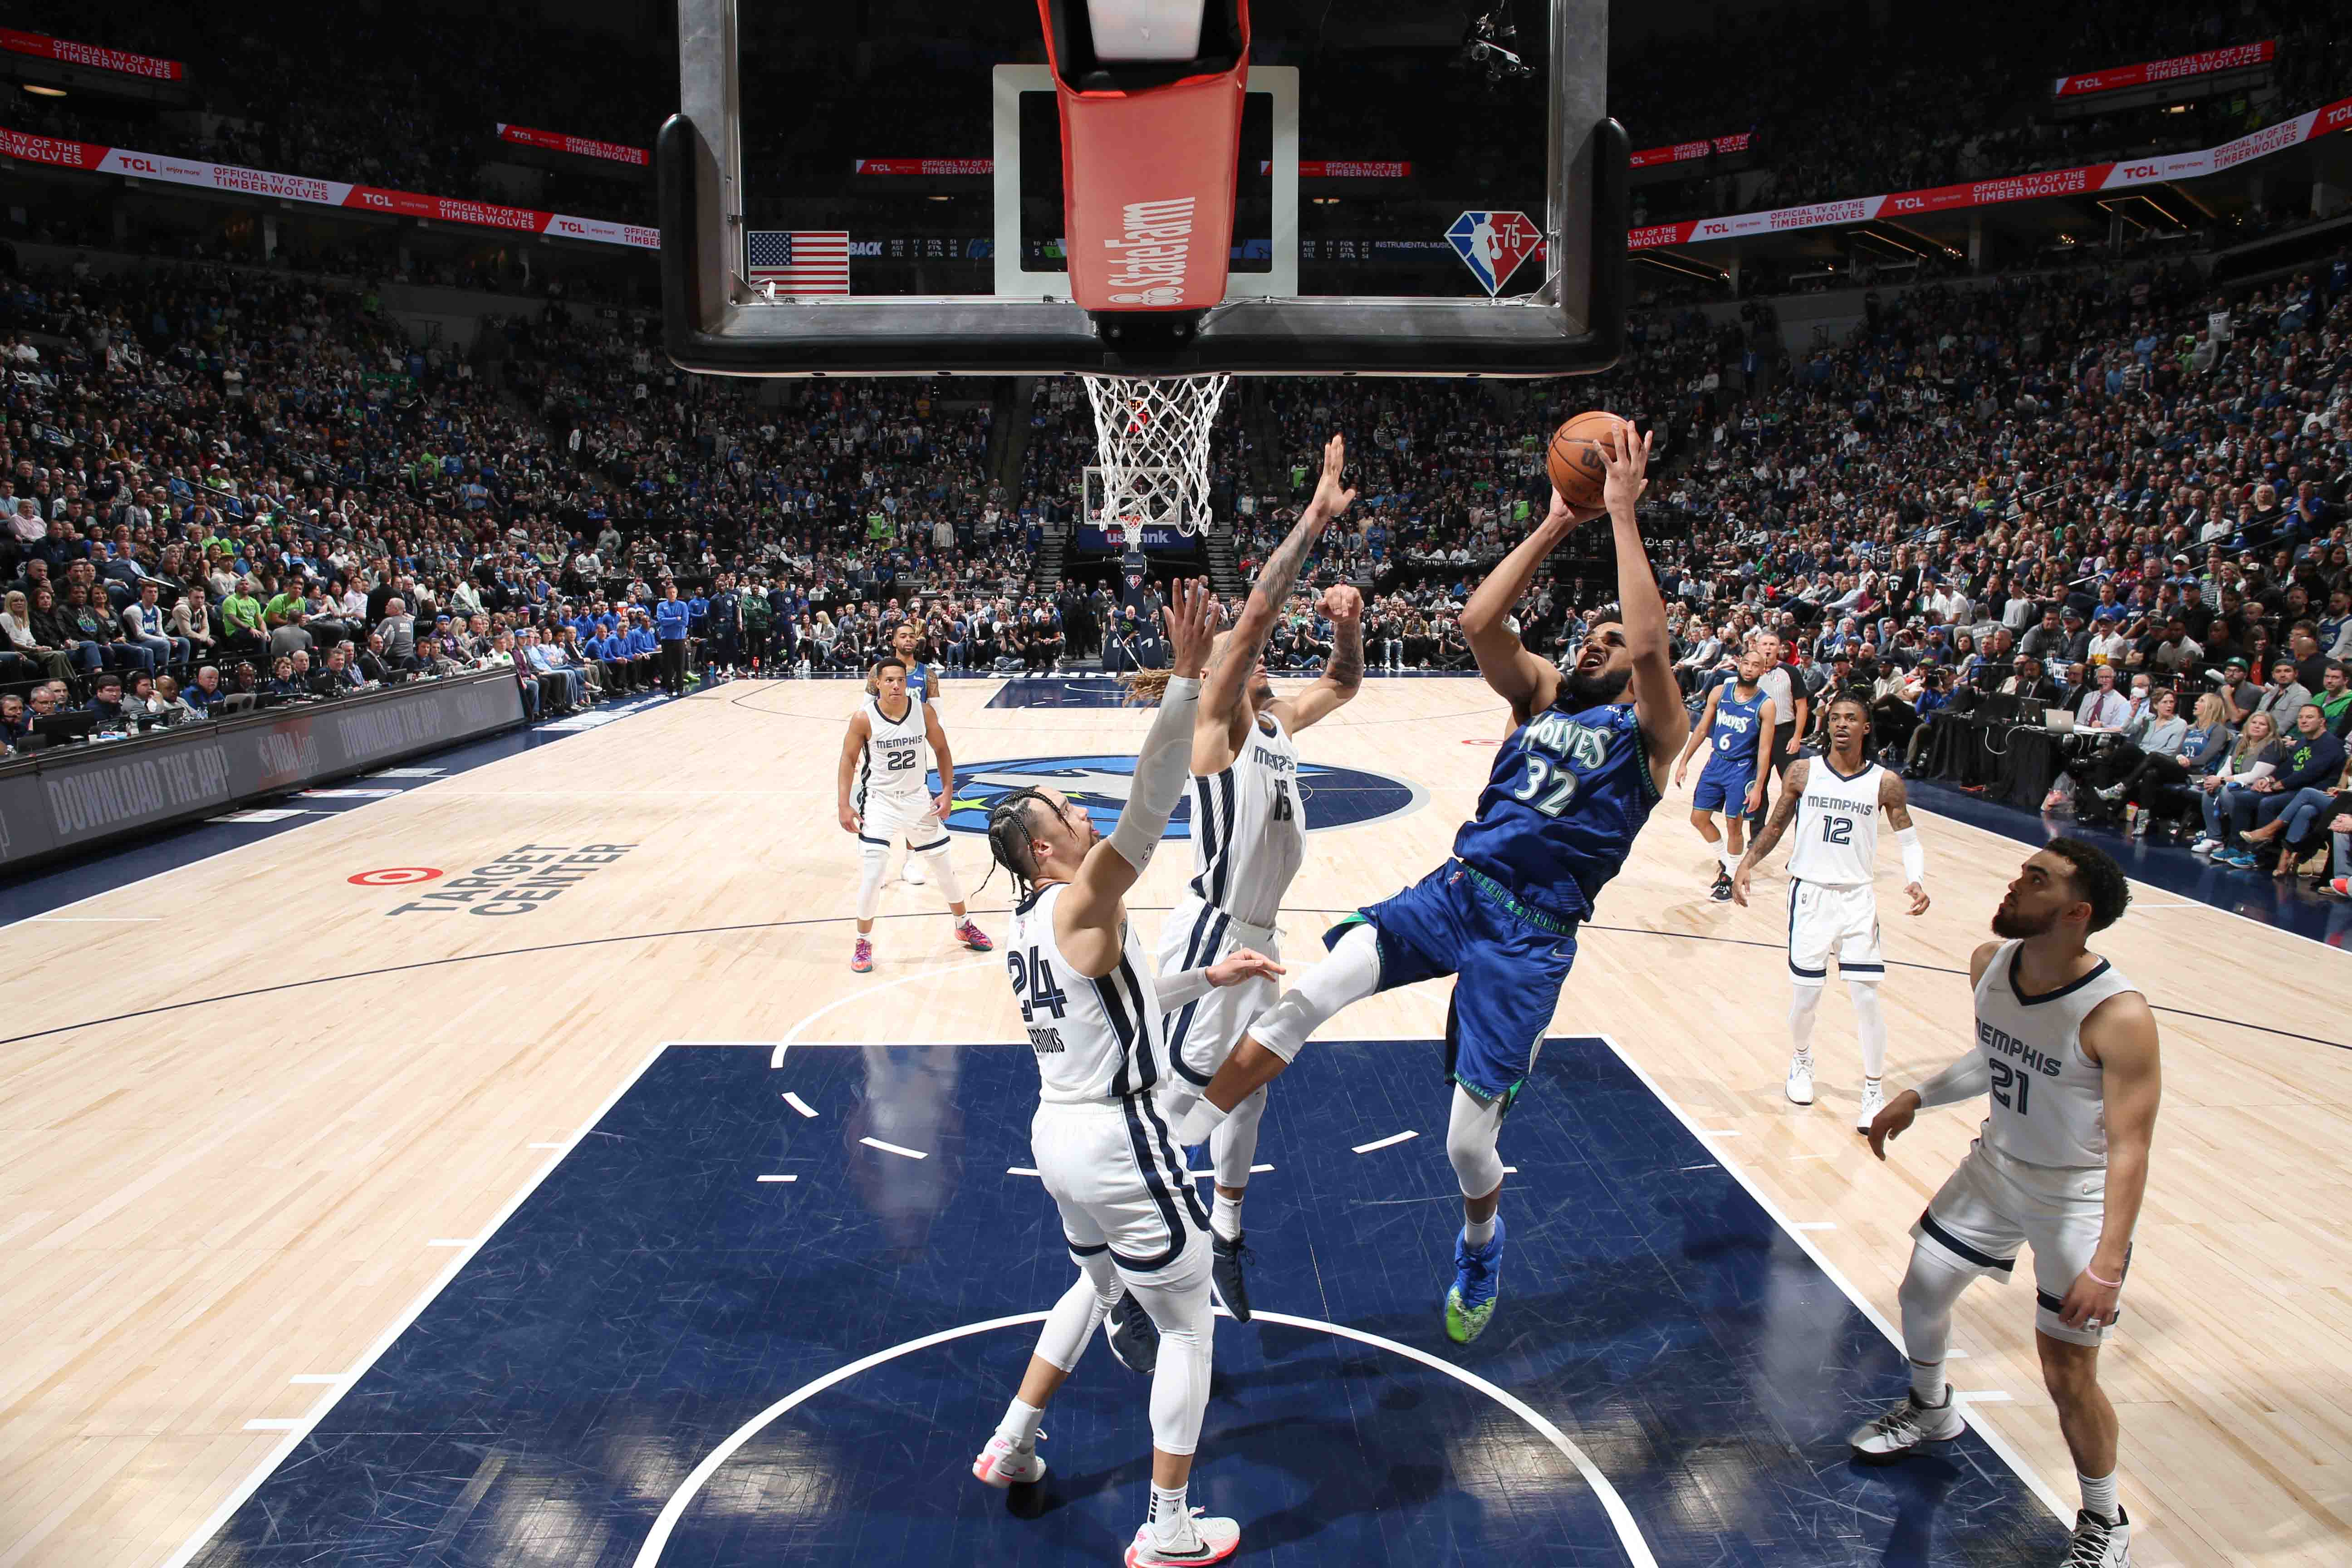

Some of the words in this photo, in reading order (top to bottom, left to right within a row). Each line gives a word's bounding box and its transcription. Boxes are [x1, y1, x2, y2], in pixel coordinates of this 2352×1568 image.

[53, 40, 109, 58] OFFICIAL
[111, 51, 127, 61] TV
[131, 55, 145, 64] OF
[149, 59, 171, 69] THE
[53, 48, 171, 79] TIMBERWOLVES
[2146, 57, 2198, 72] OFFICIAL
[2201, 51, 2217, 62] TV
[2220, 49, 2236, 59] OF
[2239, 44, 2262, 56] THE
[2146, 53, 2262, 82] TIMBERWOLVES
[2075, 77, 2102, 89] TCL
[13, 135, 27, 144] TV
[33, 139, 50, 148] OF
[54, 142, 81, 154] THE
[512, 131, 532, 140] TCL
[2215, 139, 2251, 158] OFFICIAL
[2255, 133, 2264, 144] TV
[2268, 127, 2278, 139] OF
[2281, 121, 2298, 134] THE
[0, 139, 83, 165] ERWOLVES
[566, 137, 601, 148] OFFICIAL
[627, 147, 642, 157] THE
[566, 144, 642, 164] TIMBERWOLVES
[1674, 142, 1708, 152] OFFICIAL
[2214, 131, 2297, 168] TIMBERWOLVES
[119, 157, 156, 173] TCL
[166, 167, 182, 175] enjoy
[1630, 156, 1645, 164] CL
[214, 167, 266, 181] OFFICIAL
[272, 175, 284, 184] TV
[289, 178, 304, 186] OF
[309, 181, 327, 191] THE
[1974, 180, 2023, 193] OFFICIAL
[2028, 177, 2041, 186] TV
[2045, 174, 2060, 183] OF
[2064, 170, 2086, 180] THE
[2124, 165, 2158, 178] TCL
[214, 176, 328, 201] TIMBERWOLVES
[1973, 180, 2086, 203] TIMBERWOLVES
[363, 193, 393, 207] TCL
[439, 200, 483, 213] OFFICIAL
[501, 209, 514, 217] OF
[516, 211, 534, 220] THE
[1771, 209, 1811, 220] OFFICIAL
[1847, 201, 1864, 210] THE
[1895, 197, 1924, 210] TCL
[439, 208, 534, 229] TIMBERWOLVES
[559, 221, 585, 233] TCL
[1705, 223, 1728, 235] TCL
[1770, 210, 1865, 229] TIMBERWOLVES
[624, 235, 661, 247] TIMBER
[1503, 224, 1520, 248] 75
[1627, 234, 1677, 247] RWOLVES
[1647, 229, 1658, 237] OF
[337, 706, 397, 760] DOWNLOAD
[395, 702, 423, 741] THE
[1716, 708, 1752, 733] WOLVES
[268, 732, 299, 773] NBA
[296, 731, 319, 768] App
[876, 734, 923, 750] MEMPHIS
[1519, 715, 1619, 769] WOLVES
[1719, 734, 1733, 750] 6
[2184, 746, 2195, 758] 32
[887, 750, 916, 771] 22
[46, 760, 164, 835] DOWNLOAD
[158, 750, 199, 805] THE
[195, 745, 229, 795] APP
[1514, 753, 1578, 817] 32
[1808, 795, 1874, 816] MEMPHIS
[1823, 815, 1853, 845] 12
[385, 844, 570, 916] TARGET
[469, 843, 640, 916] CENTER
[1008, 945, 1068, 1022] 24
[1989, 1057, 2029, 1116] 21
